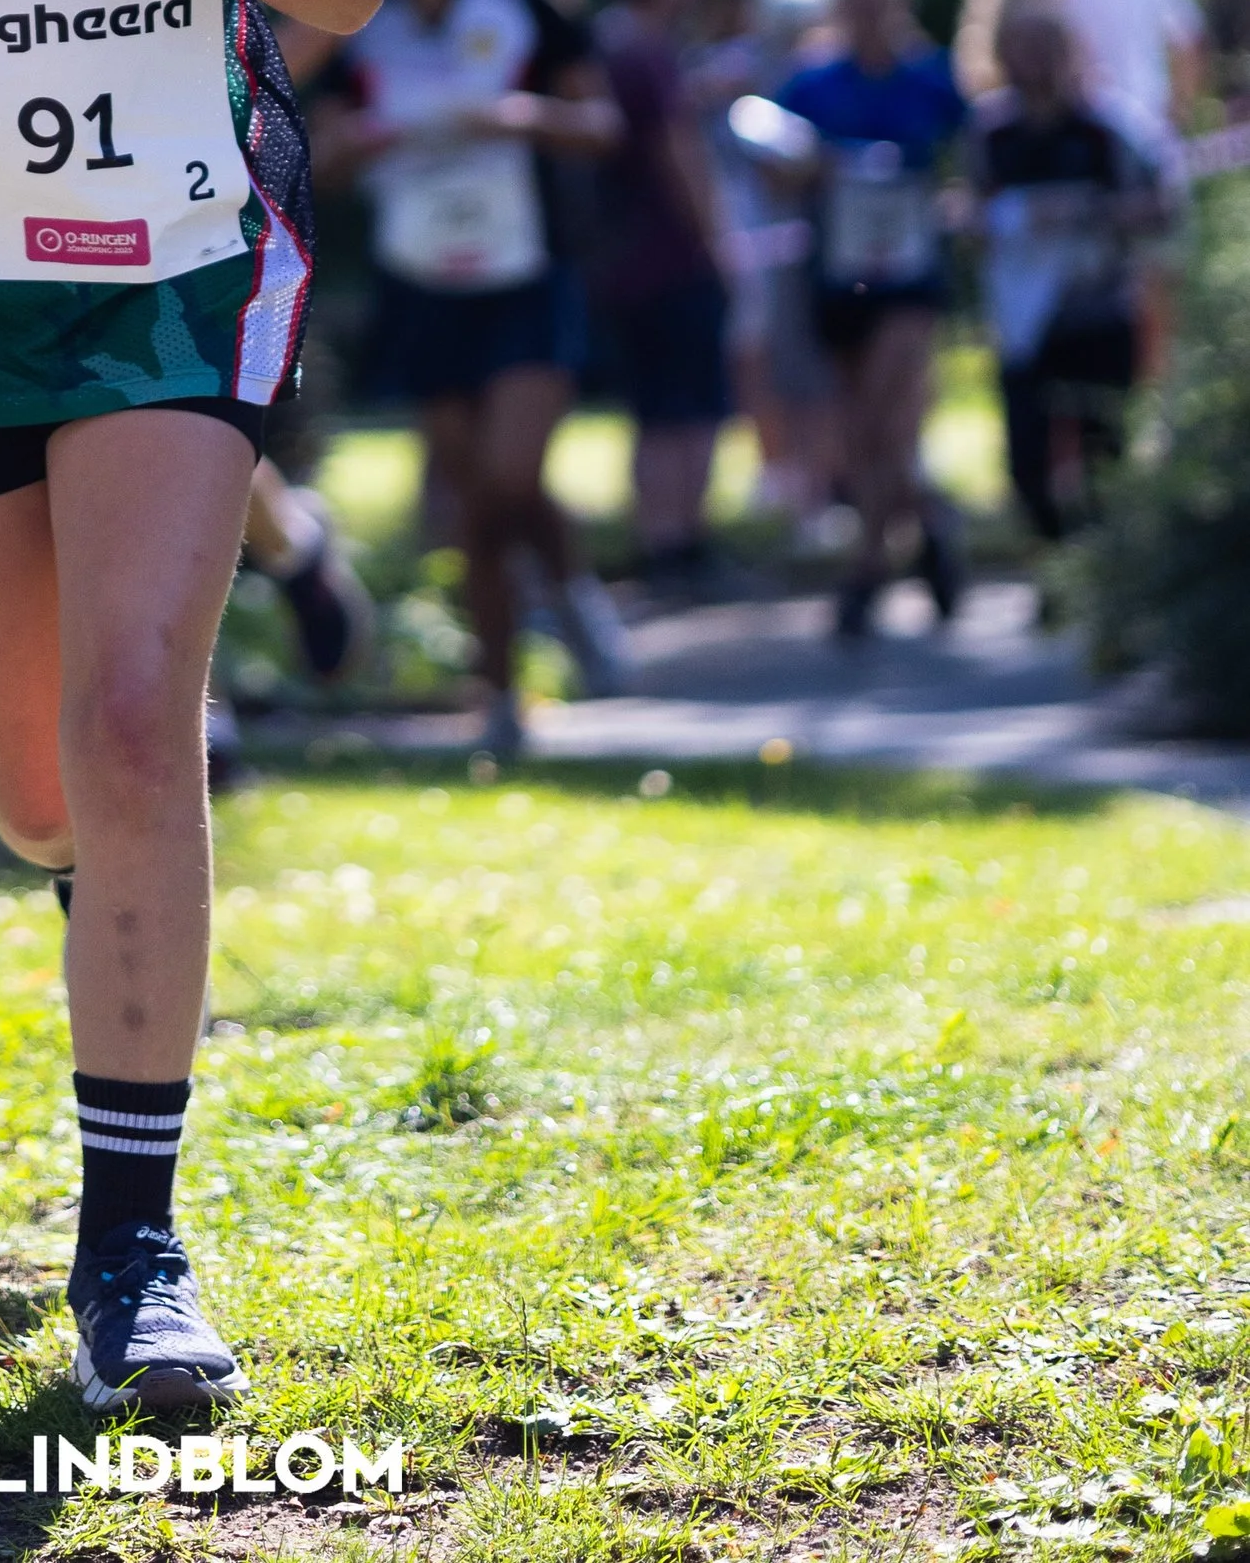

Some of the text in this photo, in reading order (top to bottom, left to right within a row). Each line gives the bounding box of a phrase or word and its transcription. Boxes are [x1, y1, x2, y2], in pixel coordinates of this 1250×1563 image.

[17, 92, 135, 175] 91
[185, 160, 216, 201] 2
[64, 231, 137, 246] O-RINGEN
